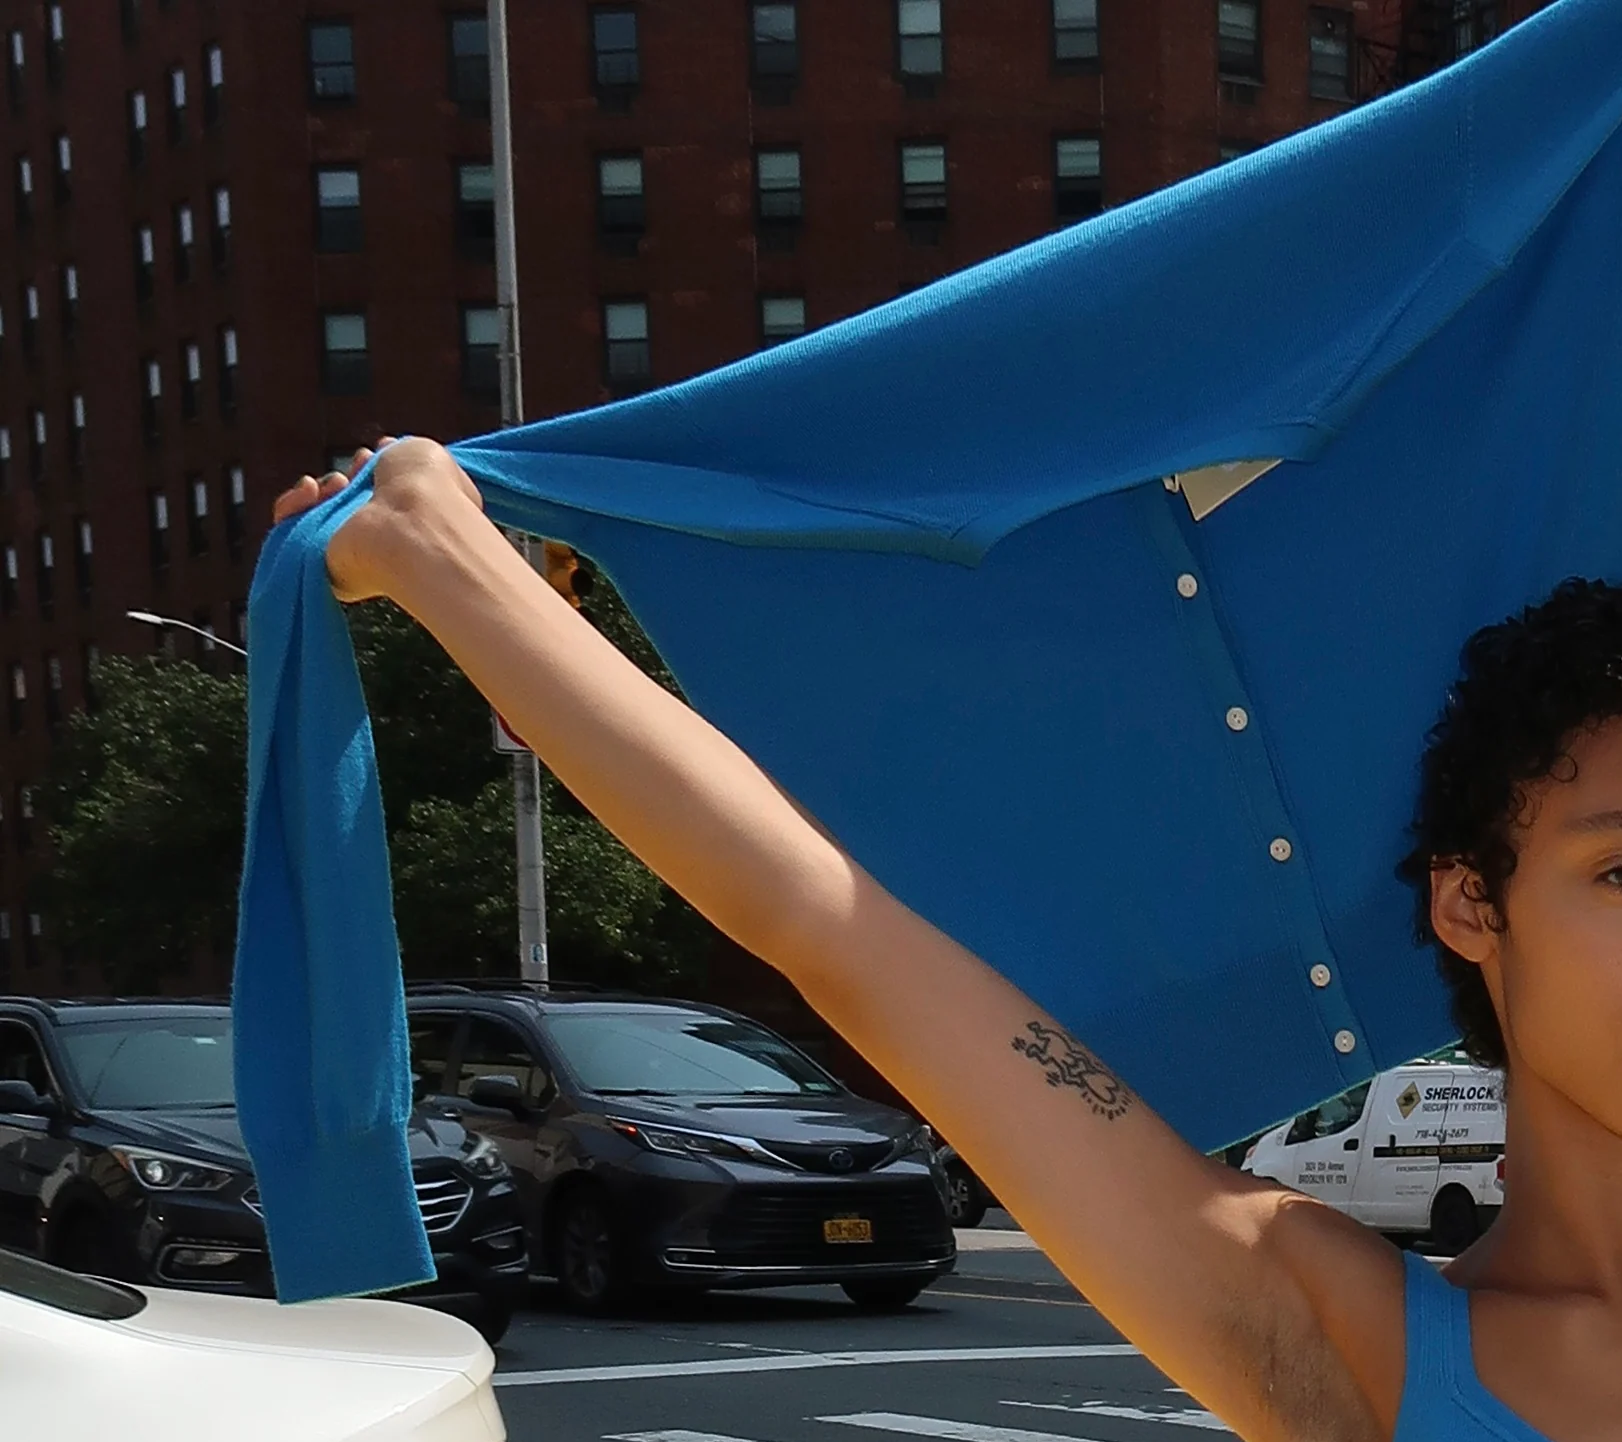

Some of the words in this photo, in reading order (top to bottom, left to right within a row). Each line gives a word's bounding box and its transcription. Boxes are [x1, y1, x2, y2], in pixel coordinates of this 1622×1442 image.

[1424, 1086, 1495, 1100] SHERLOCK
[1422, 1102, 1459, 1112] SECURITY
[1463, 1102, 1498, 1112] SYSTEMS
